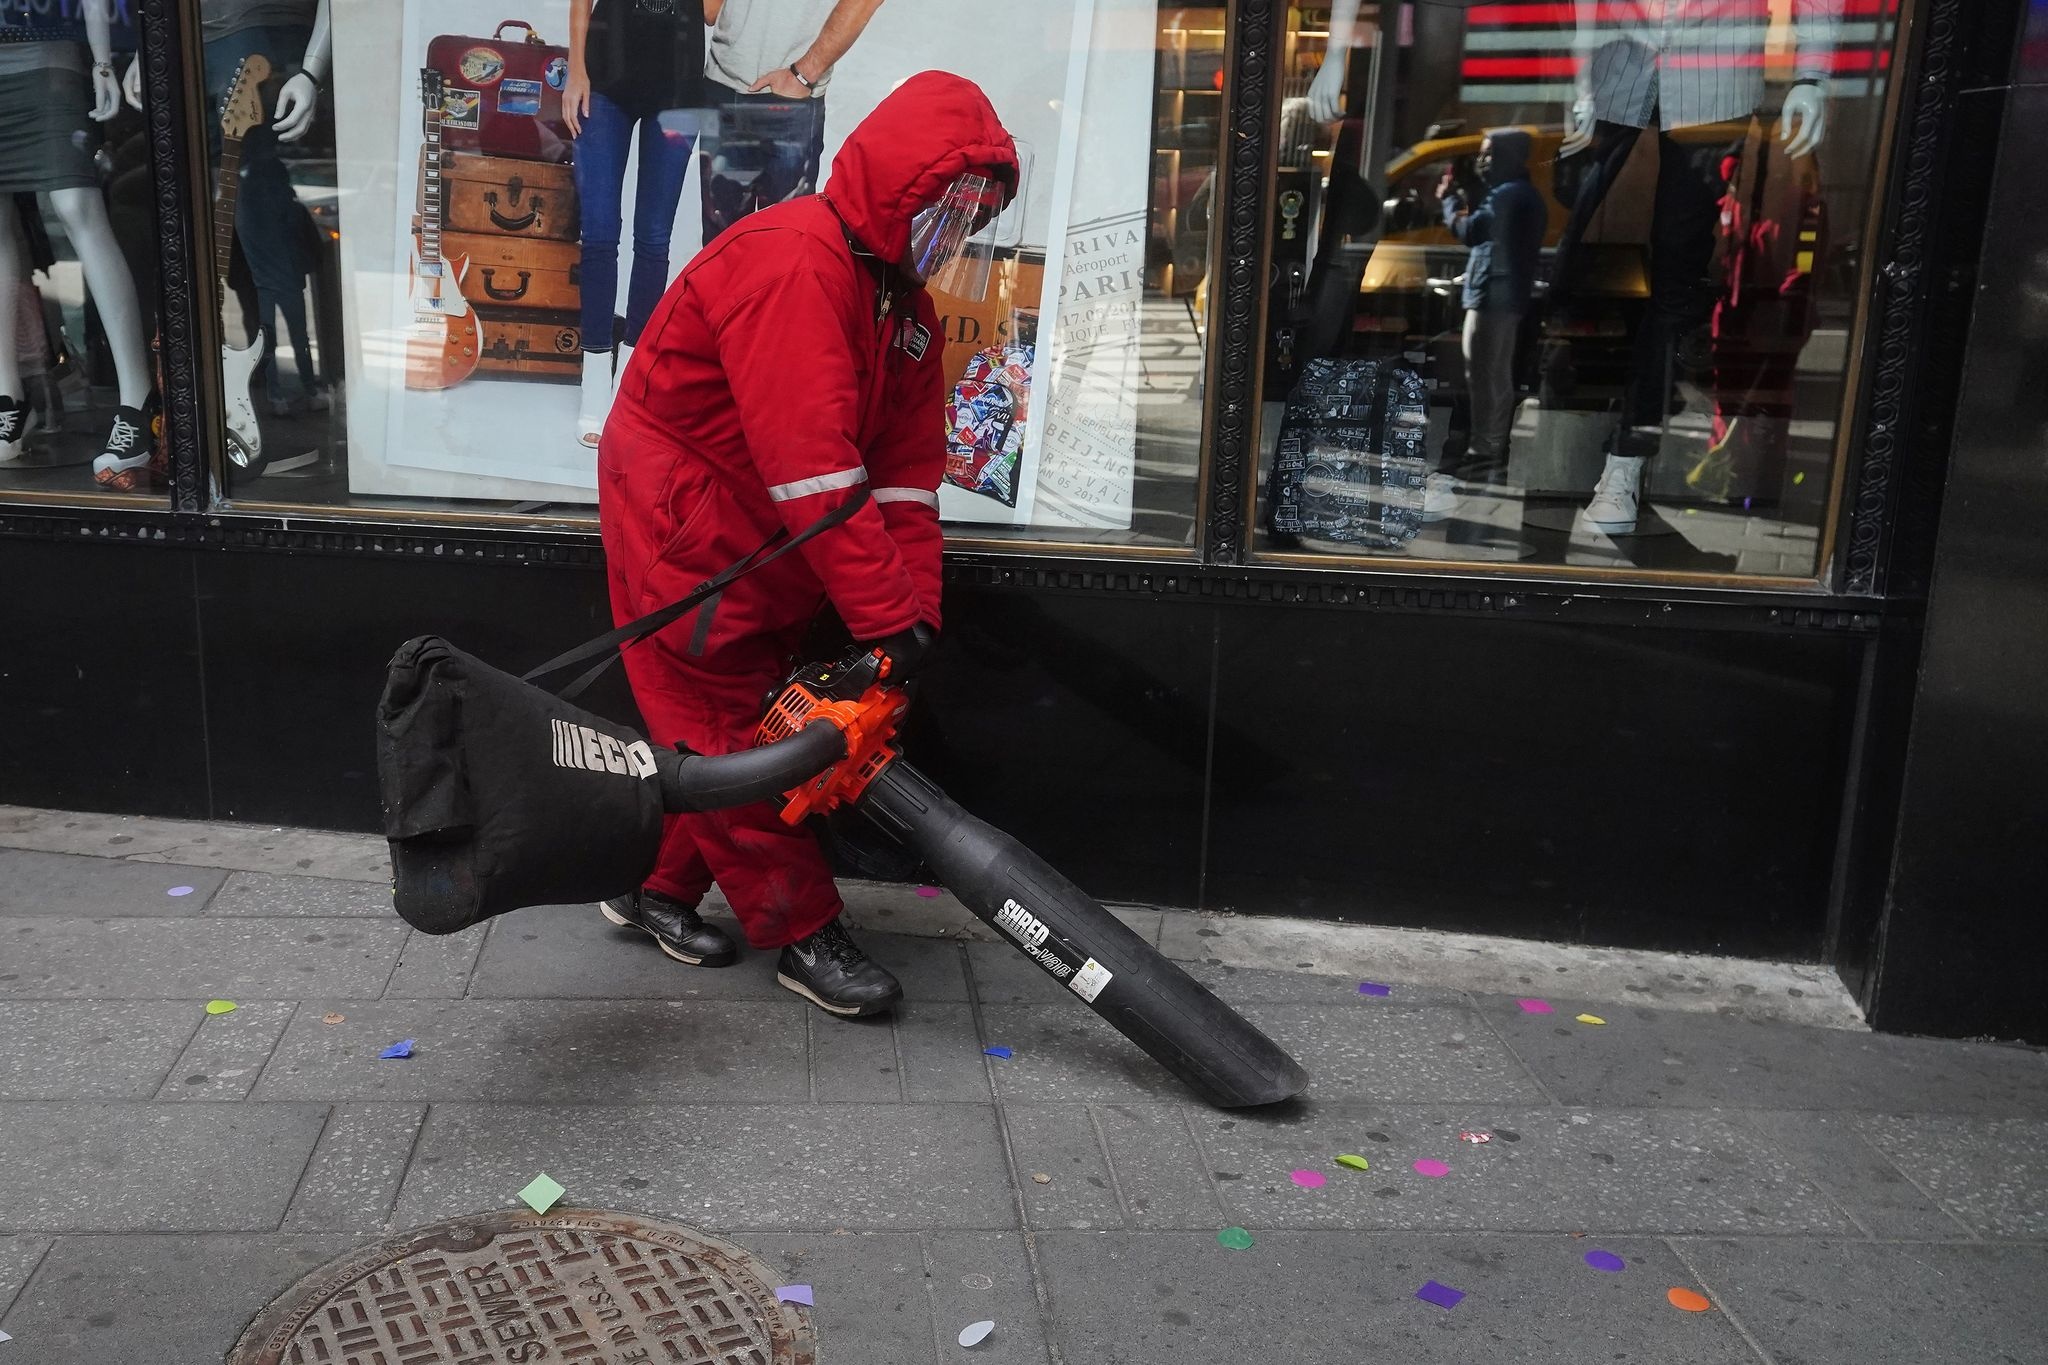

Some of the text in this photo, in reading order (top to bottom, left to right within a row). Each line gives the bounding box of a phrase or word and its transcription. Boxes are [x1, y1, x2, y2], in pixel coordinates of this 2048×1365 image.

[1064, 229, 1140, 258] RIVA
[1065, 252, 1129, 276] Aéroport
[1045, 422, 1129, 478] BEIJING
[1075, 412, 1126, 446] REPUBLIC
[1039, 466, 1054, 480] AN
[1074, 487, 1101, 505] 2012
[1044, 452, 1121, 504] RRIVAL
[998, 898, 1050, 947] SHRED
[269, 1304, 312, 1350] GENERAL
[310, 1256, 383, 1304] FOUNDRIES
[464, 1261, 549, 1364] SEWER
[578, 1271, 622, 1322] USA
[763, 1304, 784, 1330] MADE
[607, 1324, 638, 1347] IN
